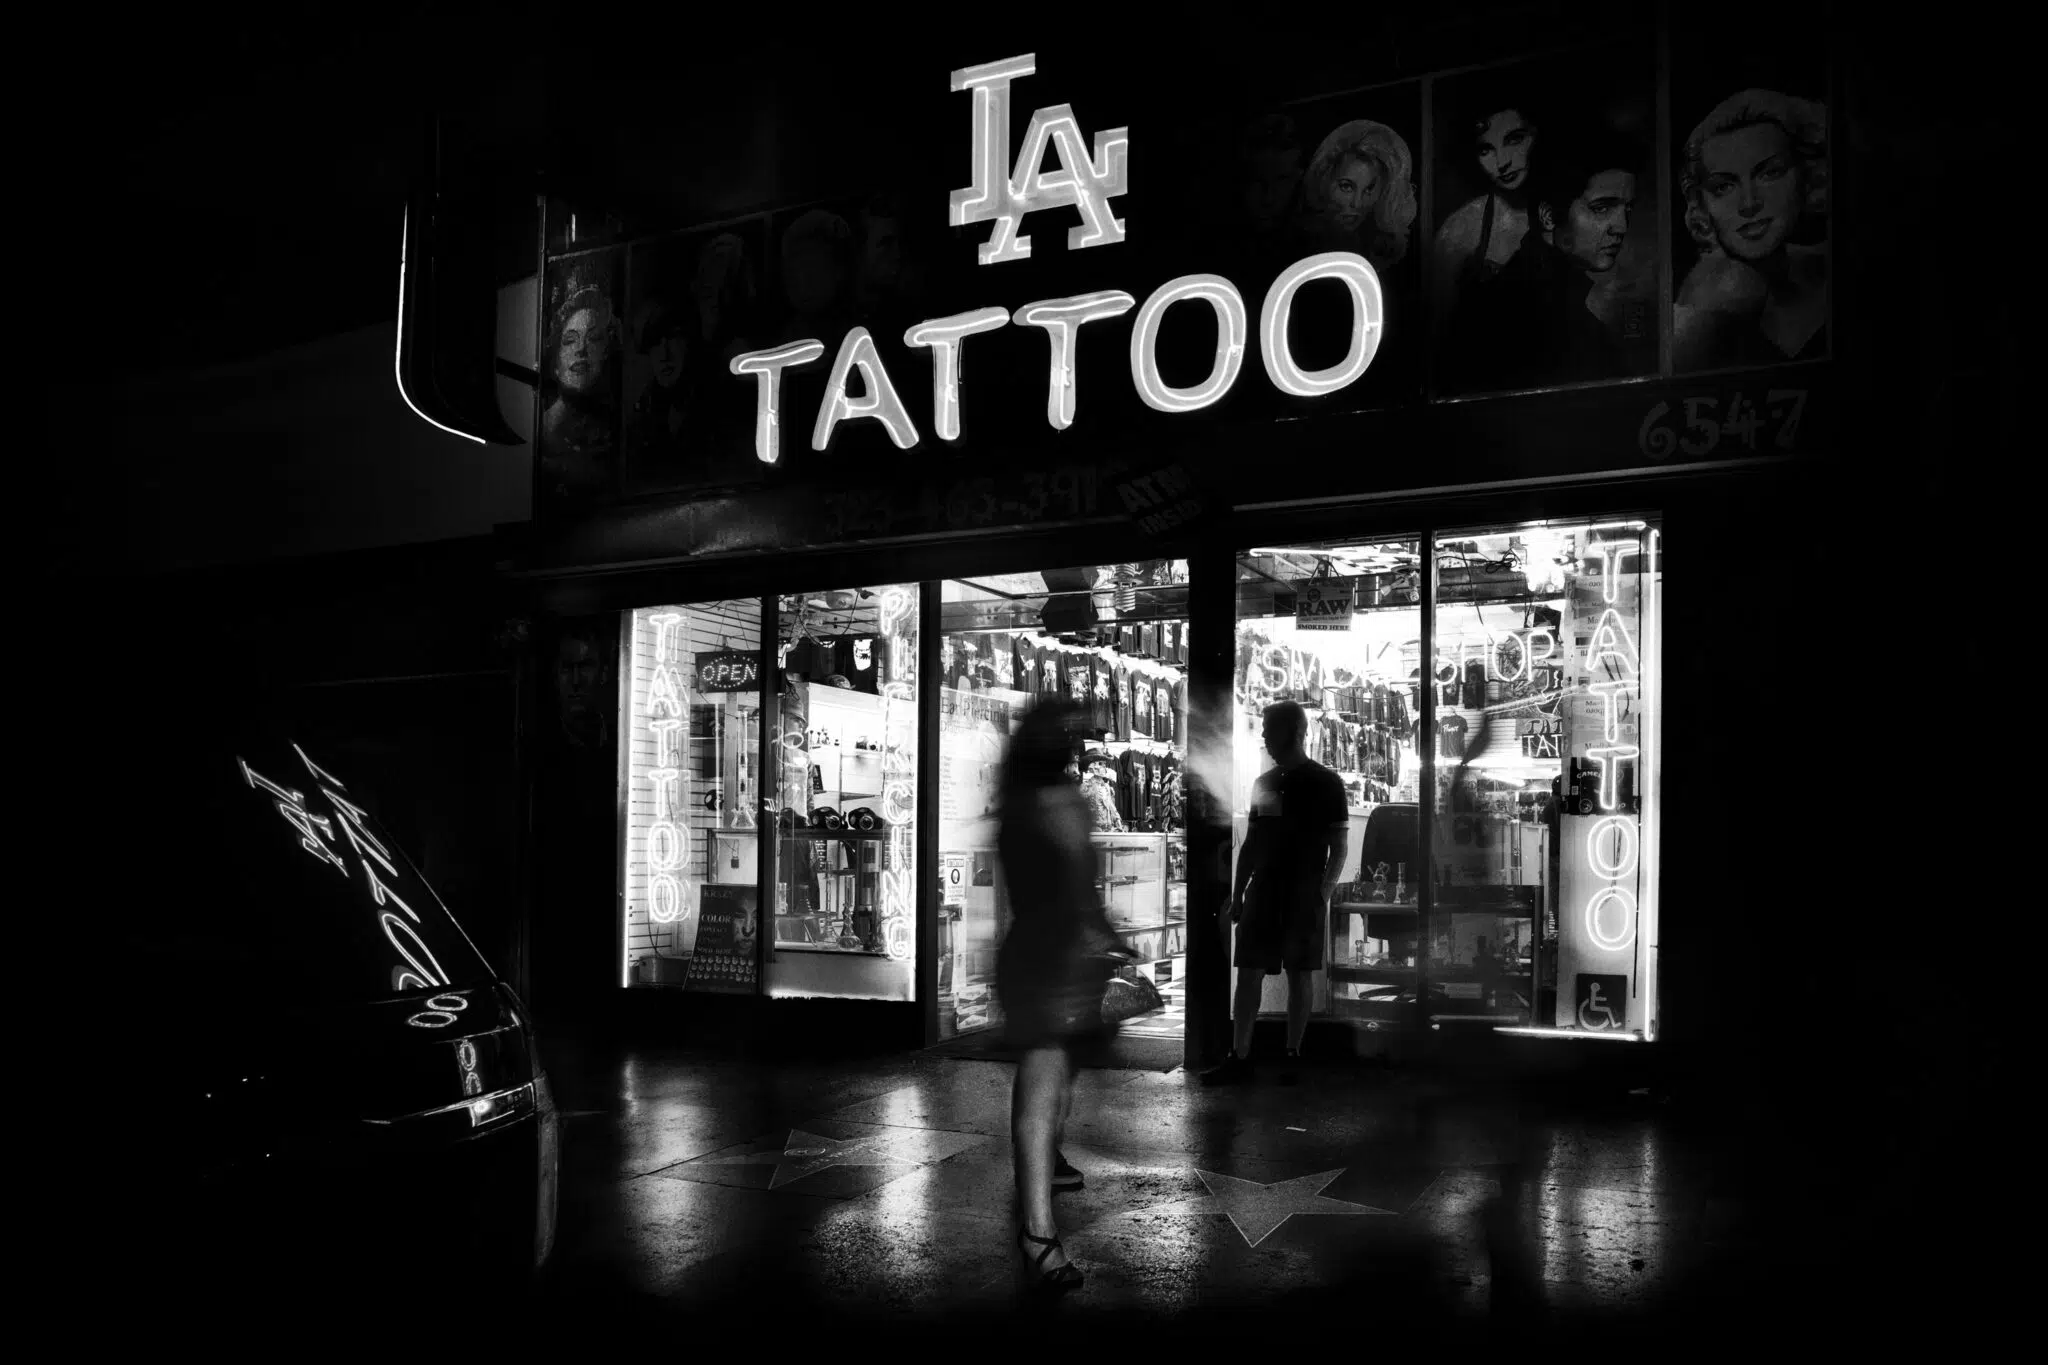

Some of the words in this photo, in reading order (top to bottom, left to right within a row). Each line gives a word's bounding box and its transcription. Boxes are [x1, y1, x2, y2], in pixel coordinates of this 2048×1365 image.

[949, 52, 1128, 265] LA
[729, 251, 1384, 464] TATTOO
[1638, 388, 1809, 461] 6547
[702, 664, 757, 681] OPEN
[1296, 623, 1328, 631] SMOKED
[1329, 624, 1350, 632] HERE
[1297, 599, 1351, 617] RAW
[647, 613, 682, 923] TATTOO
[1585, 540, 1642, 951] TATTOO
